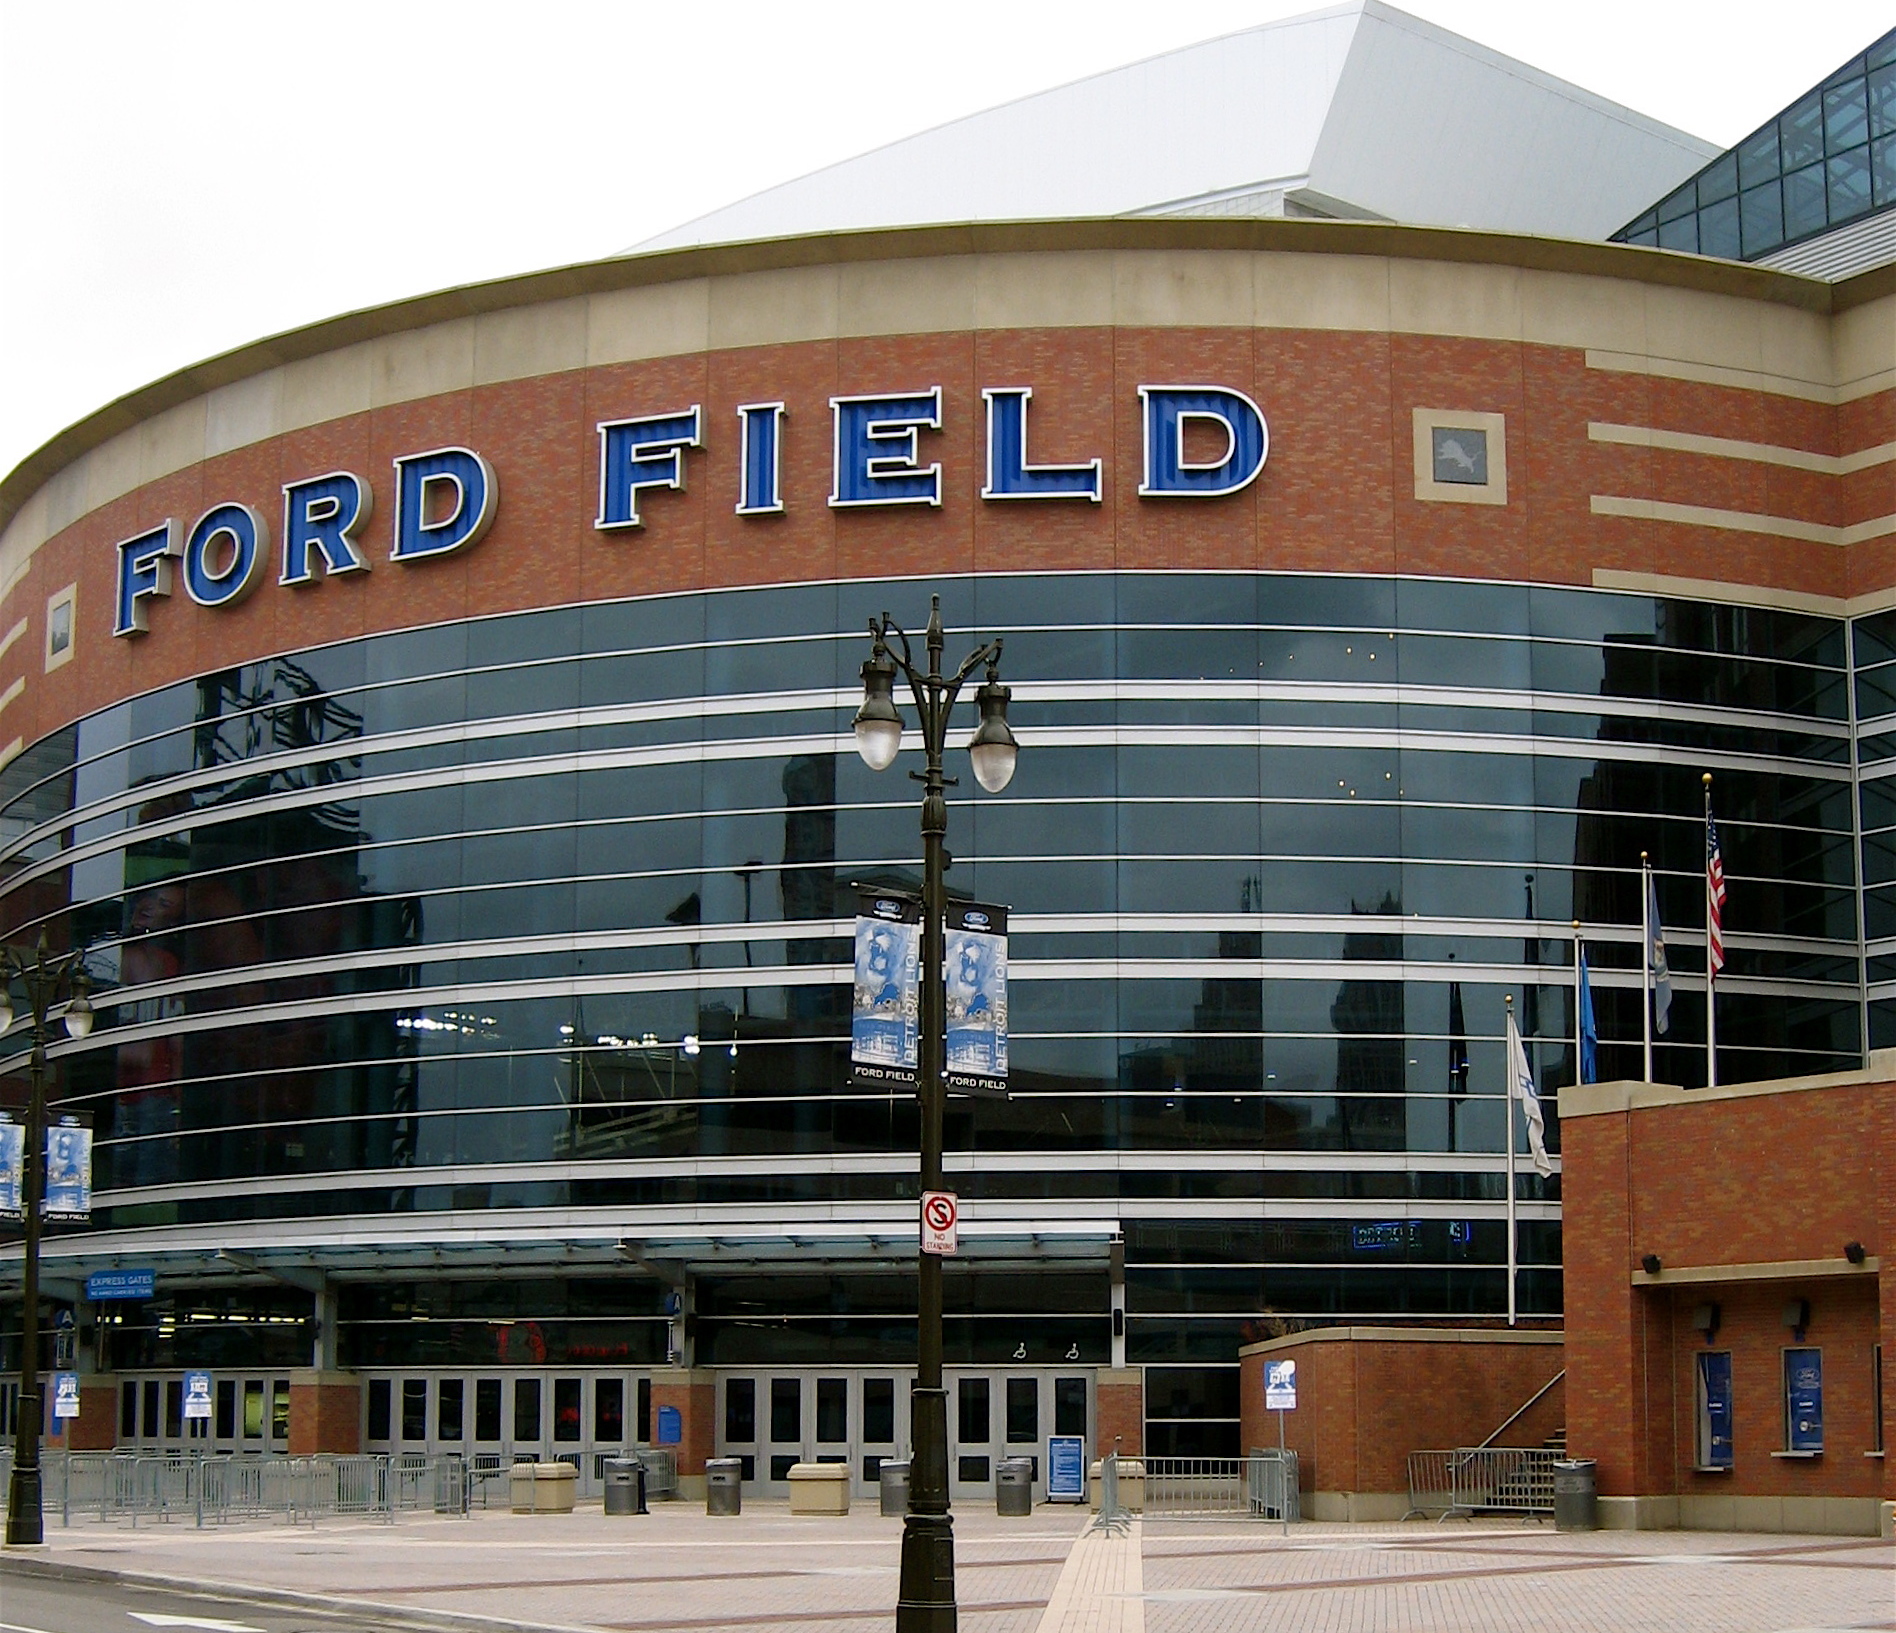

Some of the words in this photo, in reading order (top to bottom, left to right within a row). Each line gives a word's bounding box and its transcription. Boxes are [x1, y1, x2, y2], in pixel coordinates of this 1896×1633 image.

[112, 447, 498, 638] FORD
[594, 384, 1269, 530] FIELD
[905, 930, 917, 984] LIONS
[995, 942, 1006, 994] LIONS
[904, 987, 916, 1062] DETROIT
[995, 998, 1006, 1072] DETROIT
[855, 1067, 883, 1078] FORD
[885, 1070, 914, 1081] FIELD
[950, 1076, 976, 1087] FORD
[978, 1079, 1006, 1090] FIELD
[934, 1232, 945, 1241] NO
[926, 1242, 954, 1251] STANDING
[91, 1276, 126, 1286] EXPRESS
[128, 1275, 152, 1285] GATES
[673, 1295, 681, 1310] A
[62, 1310, 74, 1323] A
